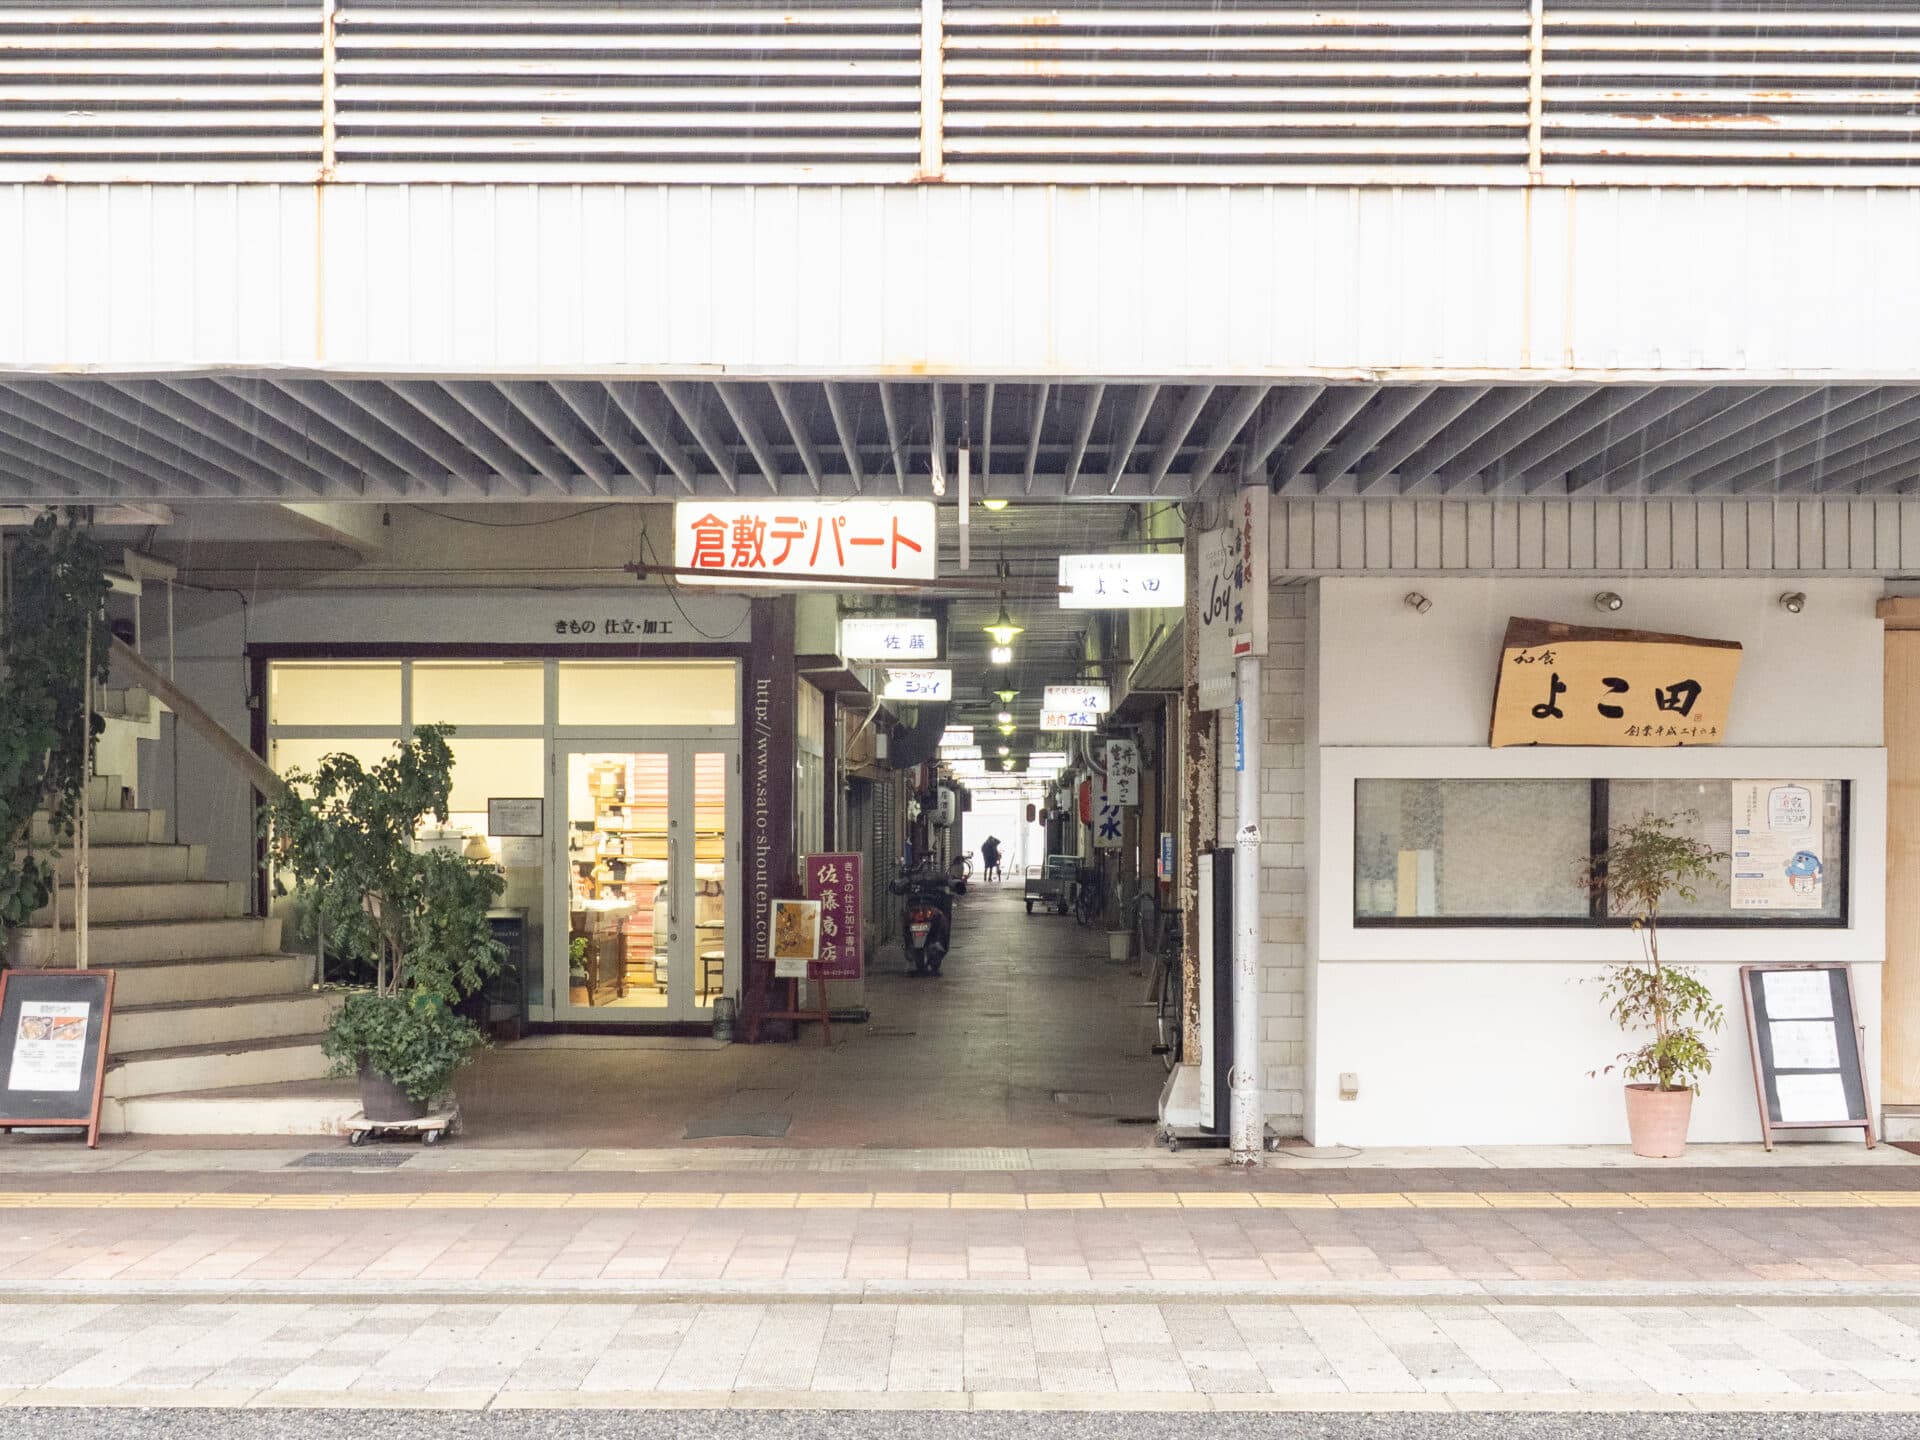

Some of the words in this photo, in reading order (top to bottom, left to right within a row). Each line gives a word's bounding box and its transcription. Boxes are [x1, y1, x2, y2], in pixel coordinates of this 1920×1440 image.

[690, 513, 923, 570] 倉敷デパート
[555, 619, 596, 634] きもの
[883, 634, 926, 650] 佐藤
[1513, 649, 1557, 665] 和食
[1531, 672, 1702, 719] よこ田
[755, 679, 771, 959] http://www.sato-shouten.com
[817, 862, 841, 961] 佐藤商店
